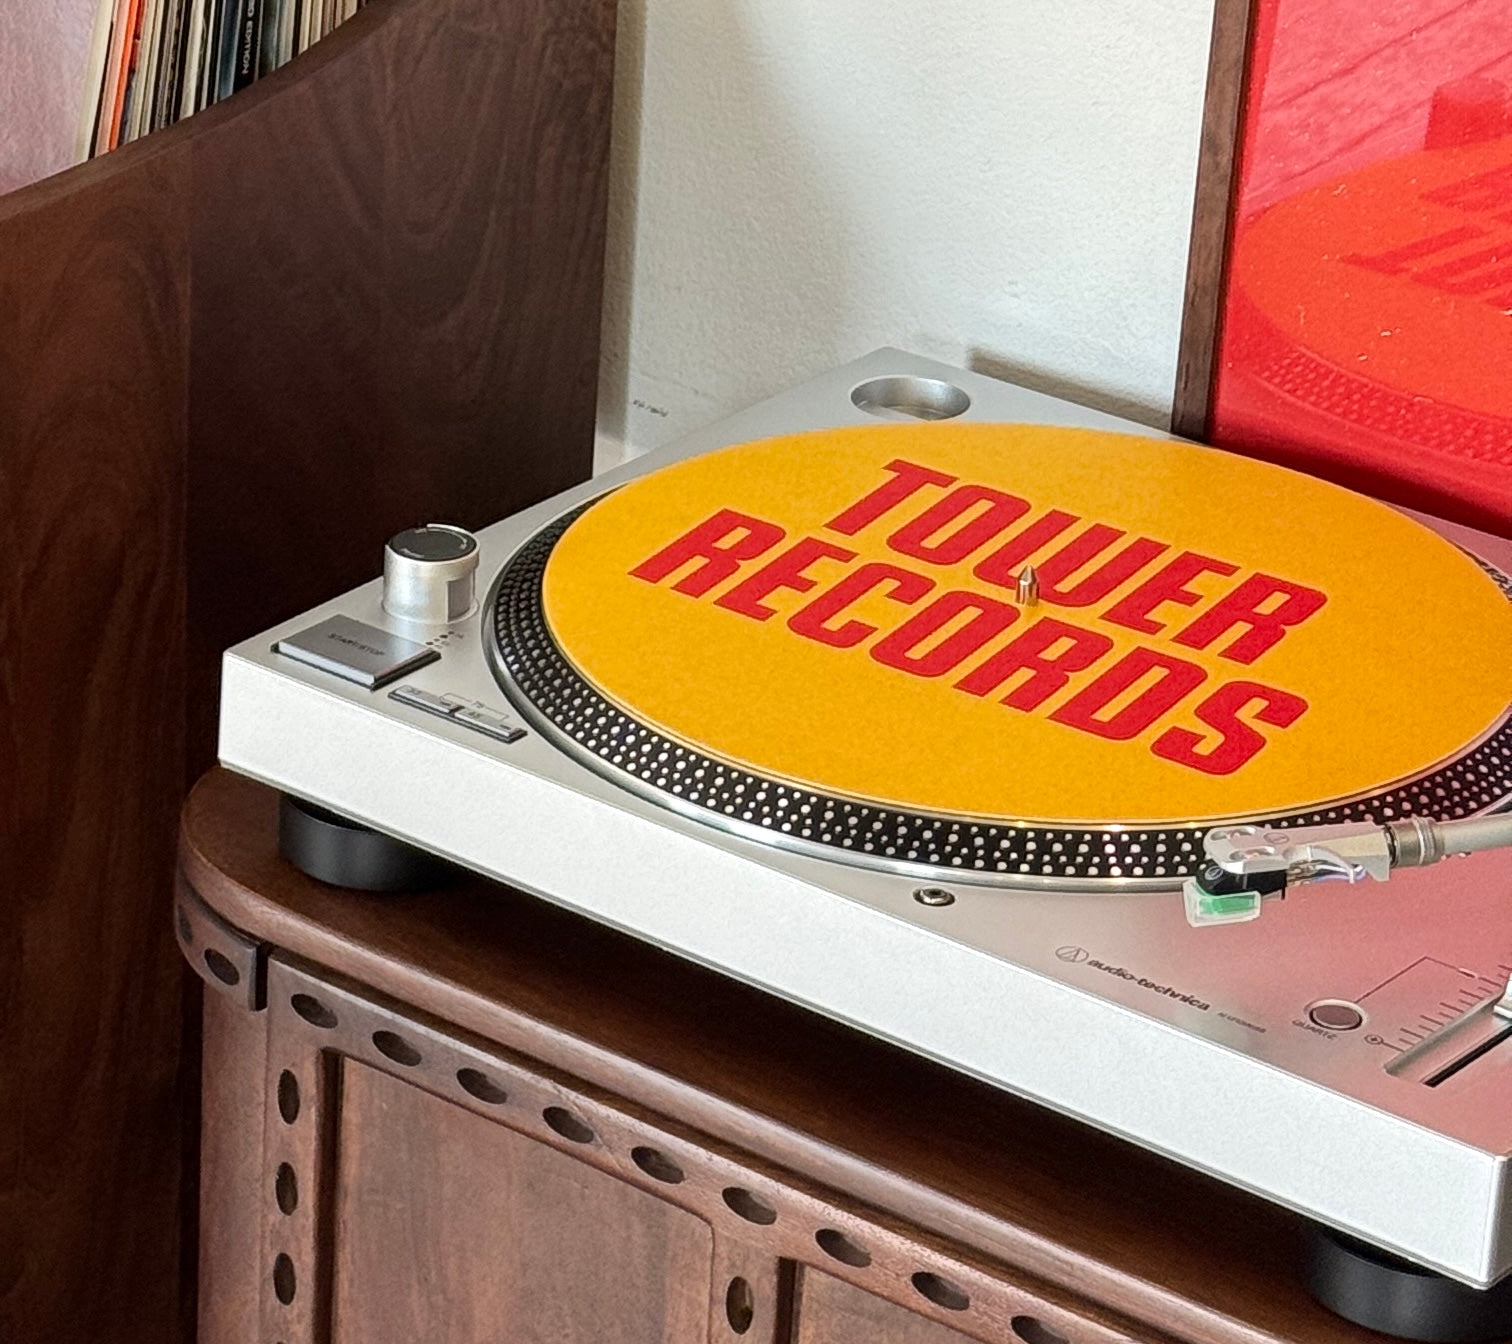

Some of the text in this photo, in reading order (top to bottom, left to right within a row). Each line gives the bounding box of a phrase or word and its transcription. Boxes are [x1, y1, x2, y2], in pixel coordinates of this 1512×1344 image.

[242, 20, 253, 75] EDITION
[822, 459, 1328, 665] TOWER
[627, 508, 1309, 776] RECORDS
[1088, 958, 1211, 1012] audio-technica
